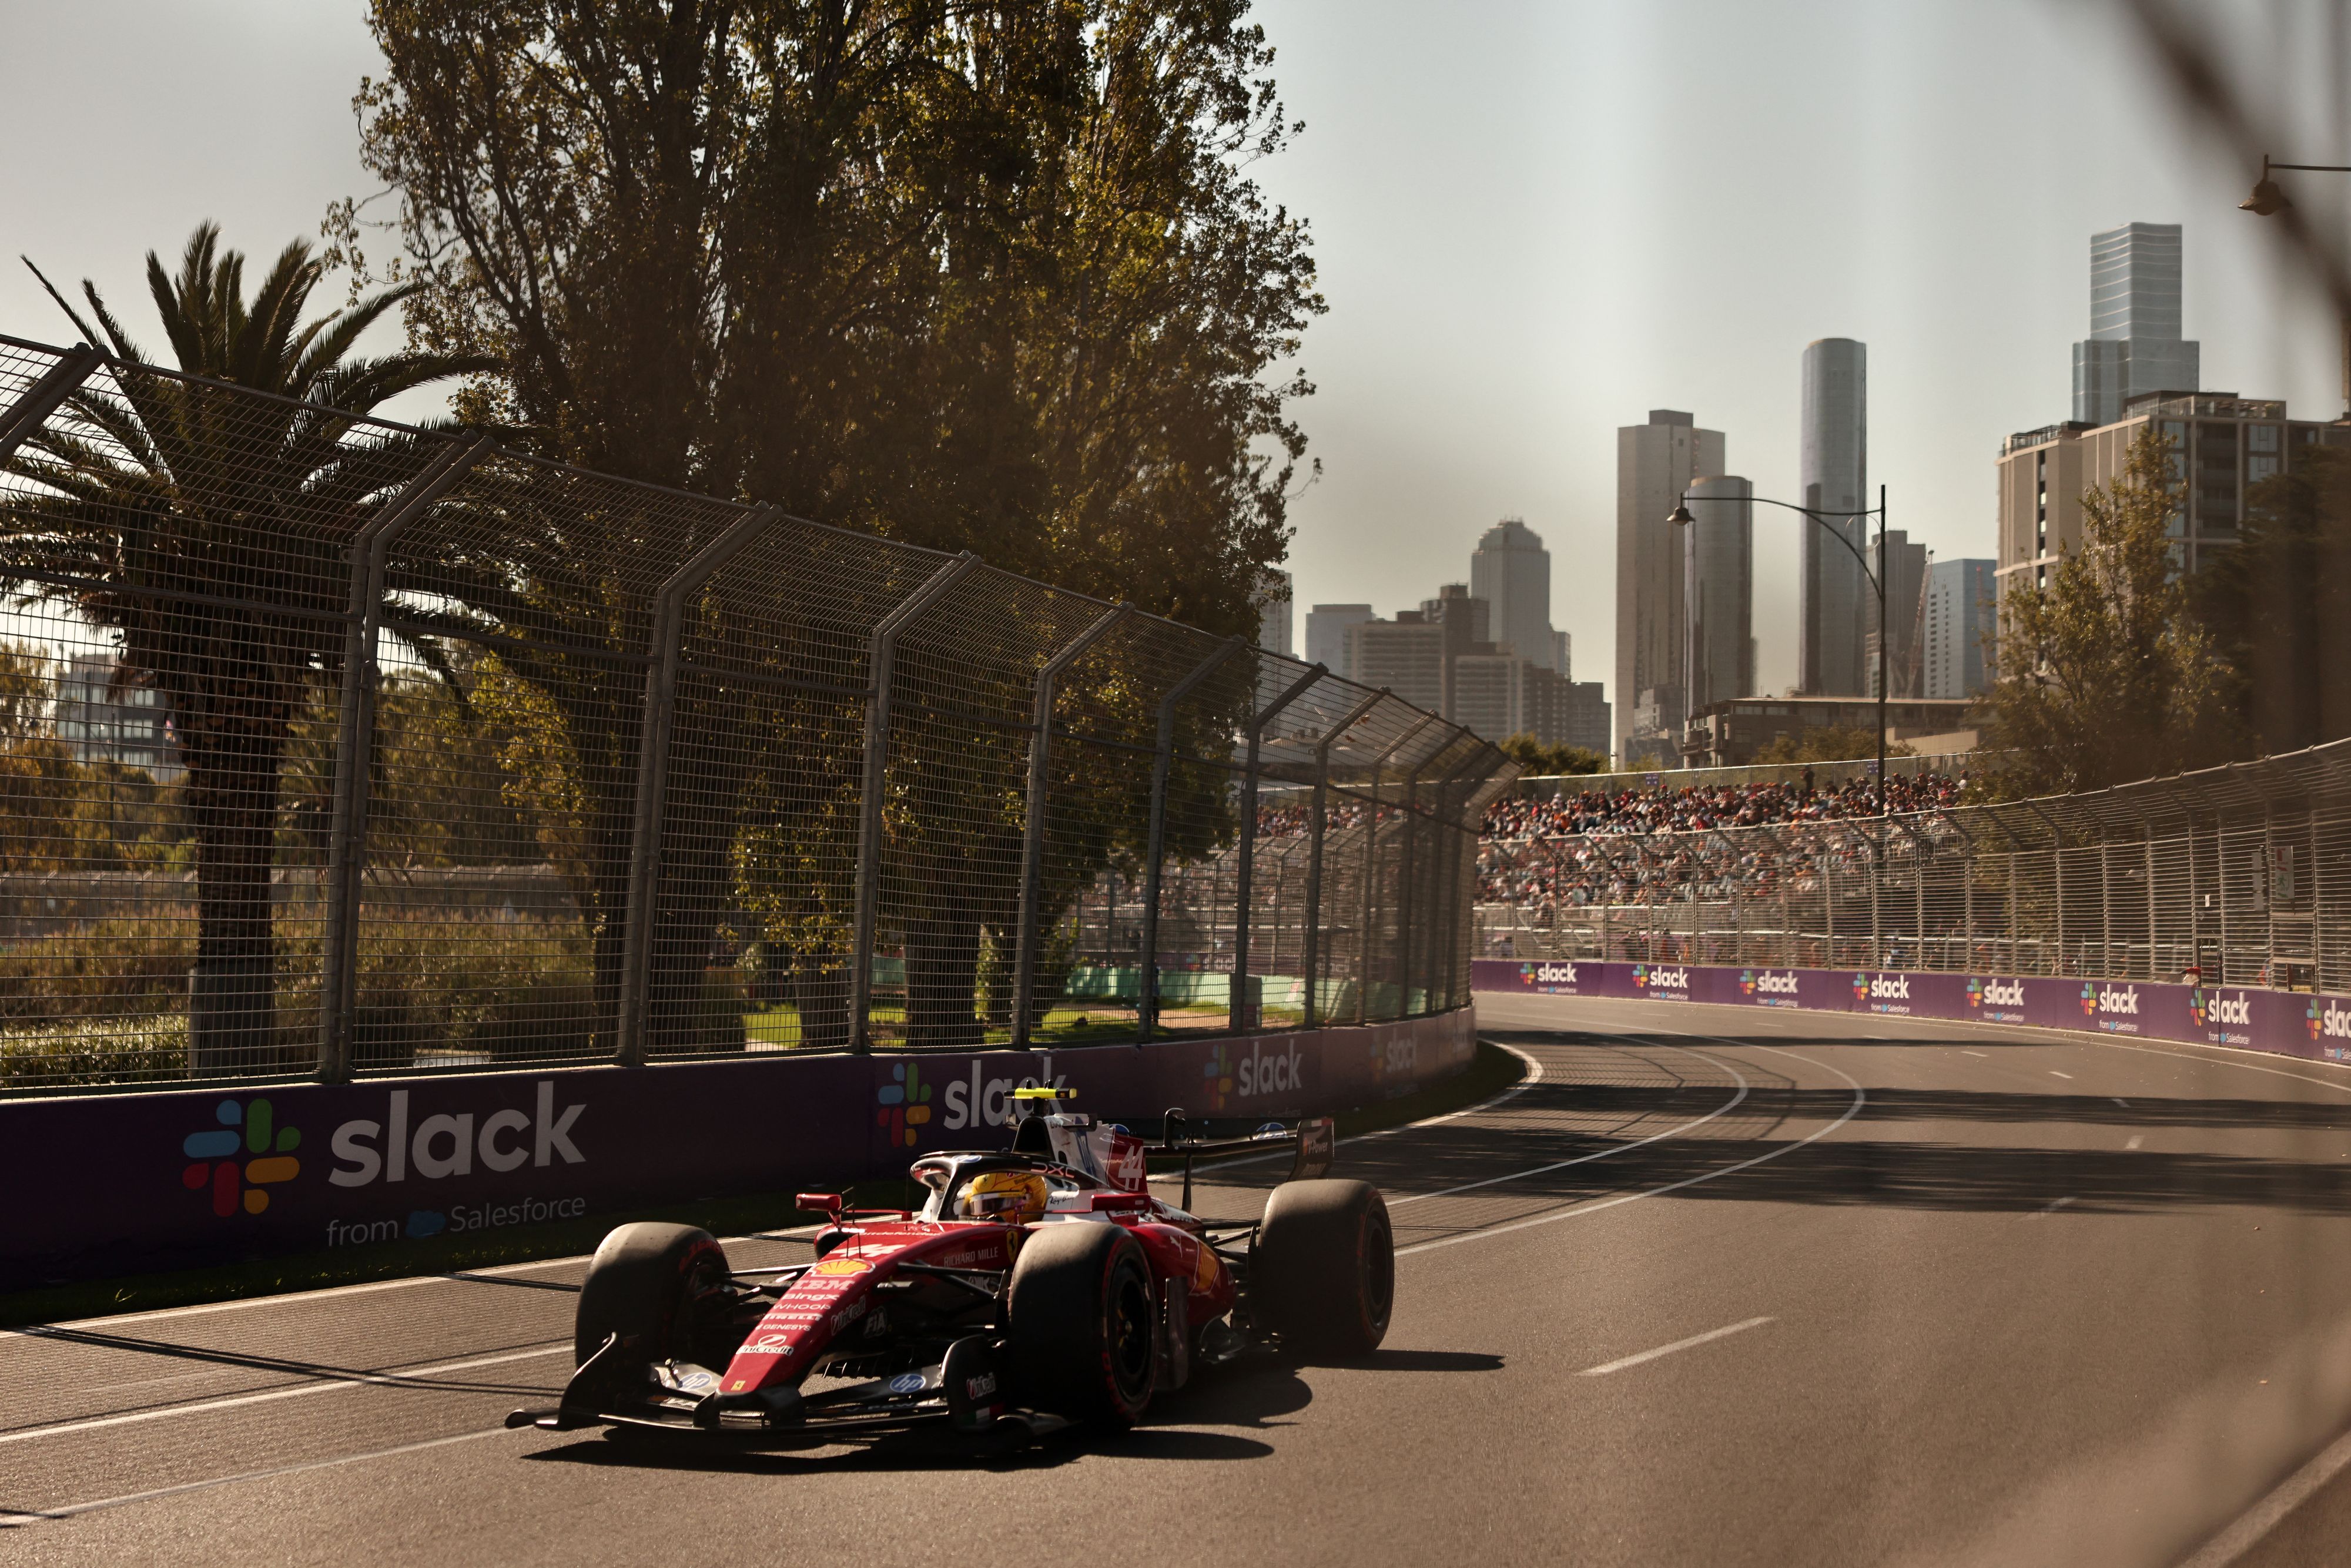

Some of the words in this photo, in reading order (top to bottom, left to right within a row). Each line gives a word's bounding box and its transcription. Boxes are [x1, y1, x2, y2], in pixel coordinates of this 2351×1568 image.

[1537, 963, 1576, 983] slack
[1650, 966, 1688, 988] slack
[1757, 970, 1798, 993] slack
[1666, 991, 1688, 1001] Salesforce
[1871, 974, 1910, 999] slack
[1984, 979, 2024, 1006] slack
[1887, 1004, 1910, 1014] Salesforce
[2099, 984, 2139, 1014] slack
[2208, 991, 2250, 1024] slack
[2001, 1012, 2024, 1022] Salesforce
[2115, 1021, 2139, 1032] Salesforce
[2226, 1033, 2250, 1045] Salesforce
[1238, 1038, 1302, 1097] slack
[943, 1056, 1067, 1130] slack
[327, 1080, 587, 1188] slack
[1308, 1140, 1328, 1155] V-Power
[1030, 1161, 1076, 1179] DXC
[1118, 1145, 1144, 1192] 44
[326, 1219, 398, 1247] from
[449, 1195, 587, 1234] Salesforce
[829, 1243, 909, 1258] 44
[943, 1250, 976, 1267] RICHARD
[977, 1246, 999, 1261] MILLE
[789, 1279, 856, 1291] IBM
[763, 1324, 812, 1332] GENESYS
